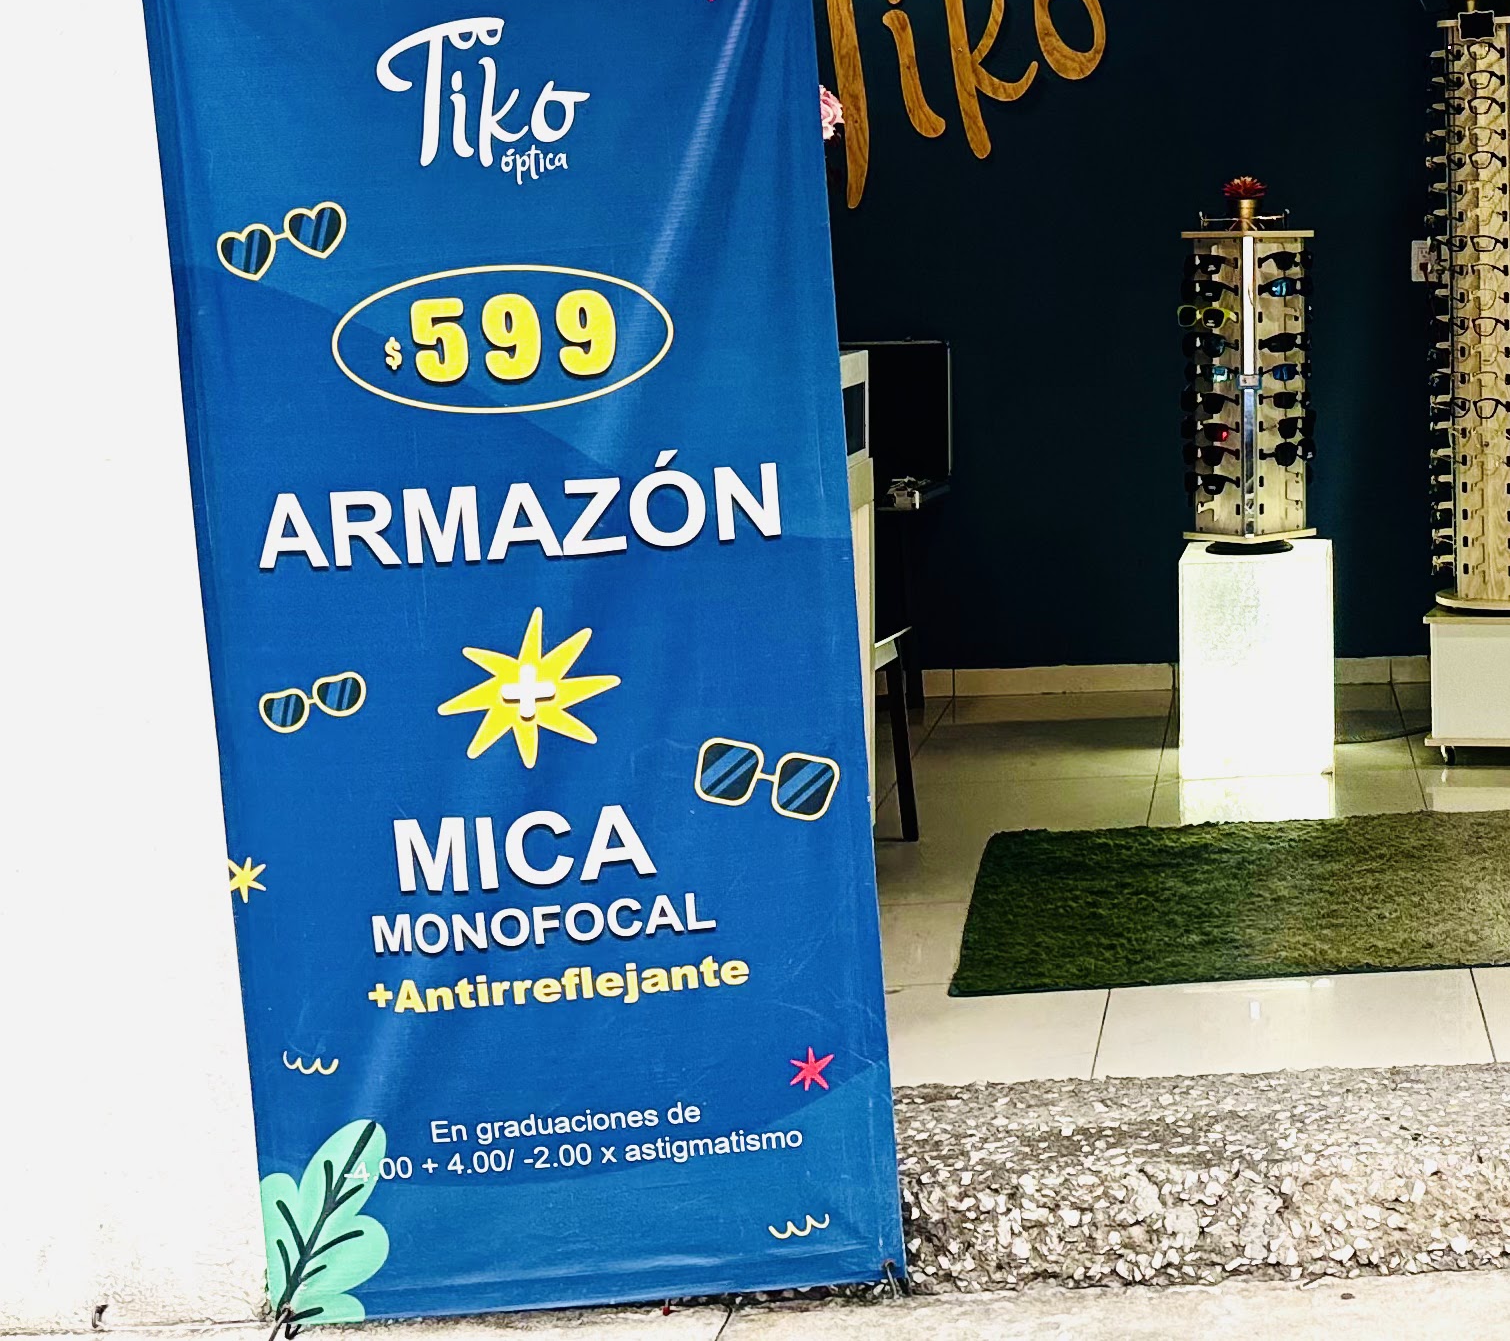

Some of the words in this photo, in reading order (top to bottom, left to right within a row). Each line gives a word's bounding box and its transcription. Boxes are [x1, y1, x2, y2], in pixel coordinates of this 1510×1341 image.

[375, 16, 591, 167] Tiko
[500, 143, 569, 185] óptica
[384, 288, 617, 384] $599
[258, 449, 783, 569] ARMAZÓN
[392, 804, 658, 893] MICA
[371, 892, 717, 955] MONOFOCAL
[367, 955, 751, 1014] +Antirreflejante
[420, 1158, 439, 1176] +
[446, 1149, 516, 1177] 4.00/
[523, 1142, 593, 1170] -2.00
[601, 1145, 618, 1164] x
[624, 1129, 803, 1162] astigmatismo
[429, 1120, 464, 1144] En
[476, 1106, 660, 1144] graduaciones
[666, 1101, 702, 1125] de
